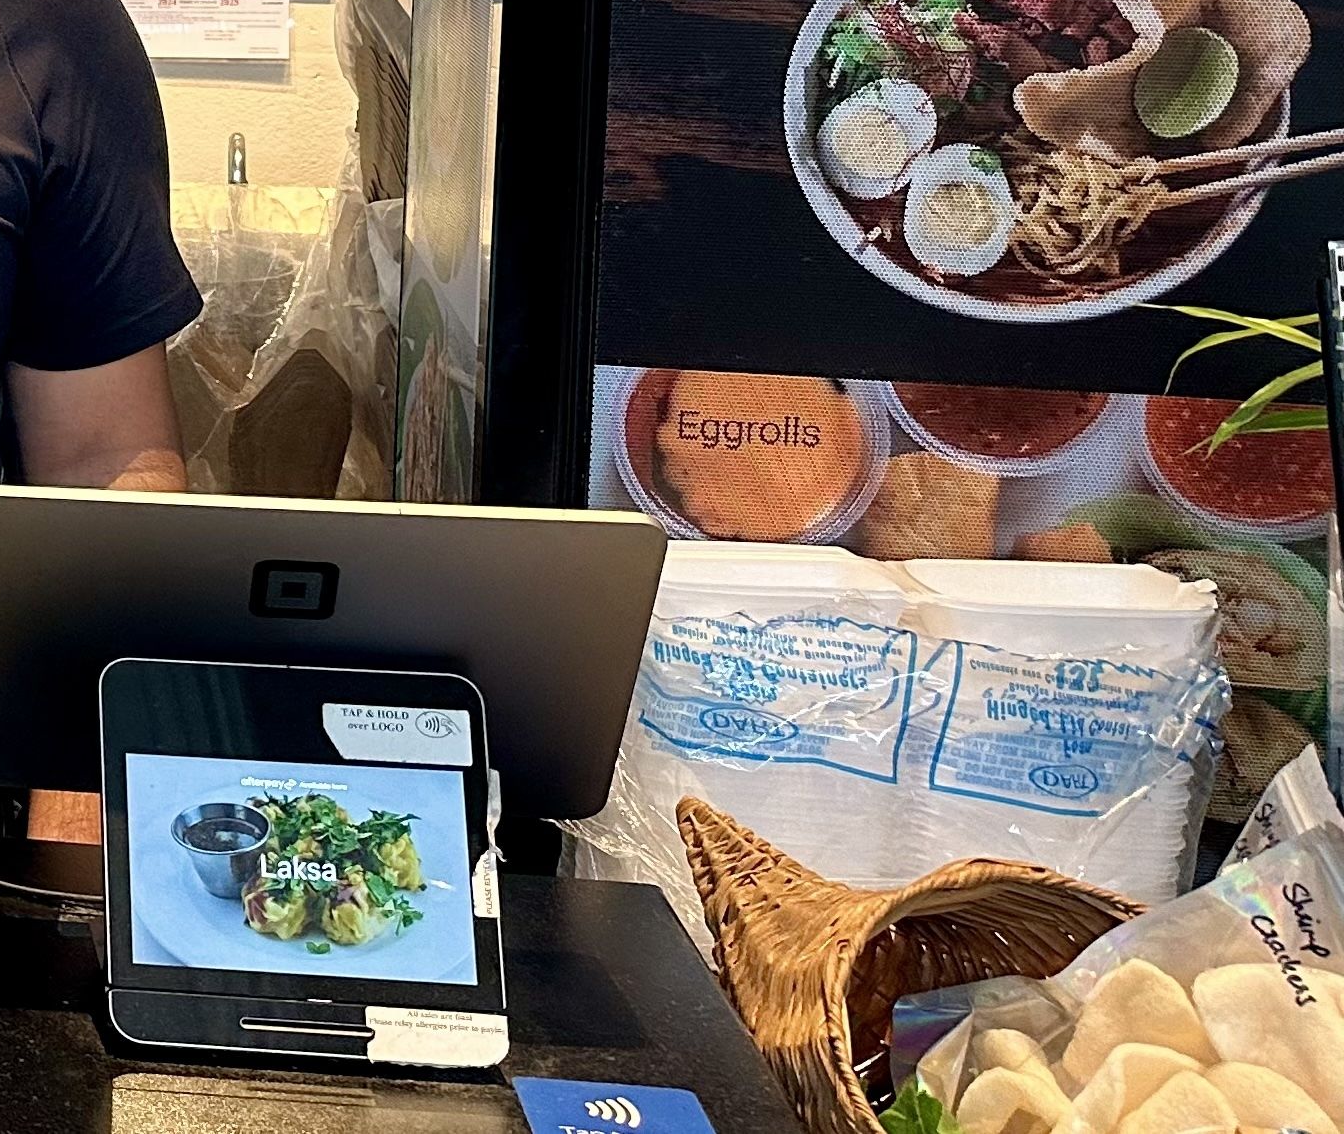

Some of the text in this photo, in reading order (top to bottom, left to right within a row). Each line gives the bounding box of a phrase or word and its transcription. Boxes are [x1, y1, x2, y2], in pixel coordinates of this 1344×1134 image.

[677, 409, 822, 451] Eggrolls
[341, 707, 409, 720] TAP & HOLD
[348, 722, 404, 732] over LOGO
[240, 776, 285, 790] afterpay
[259, 853, 338, 883] Laksa
